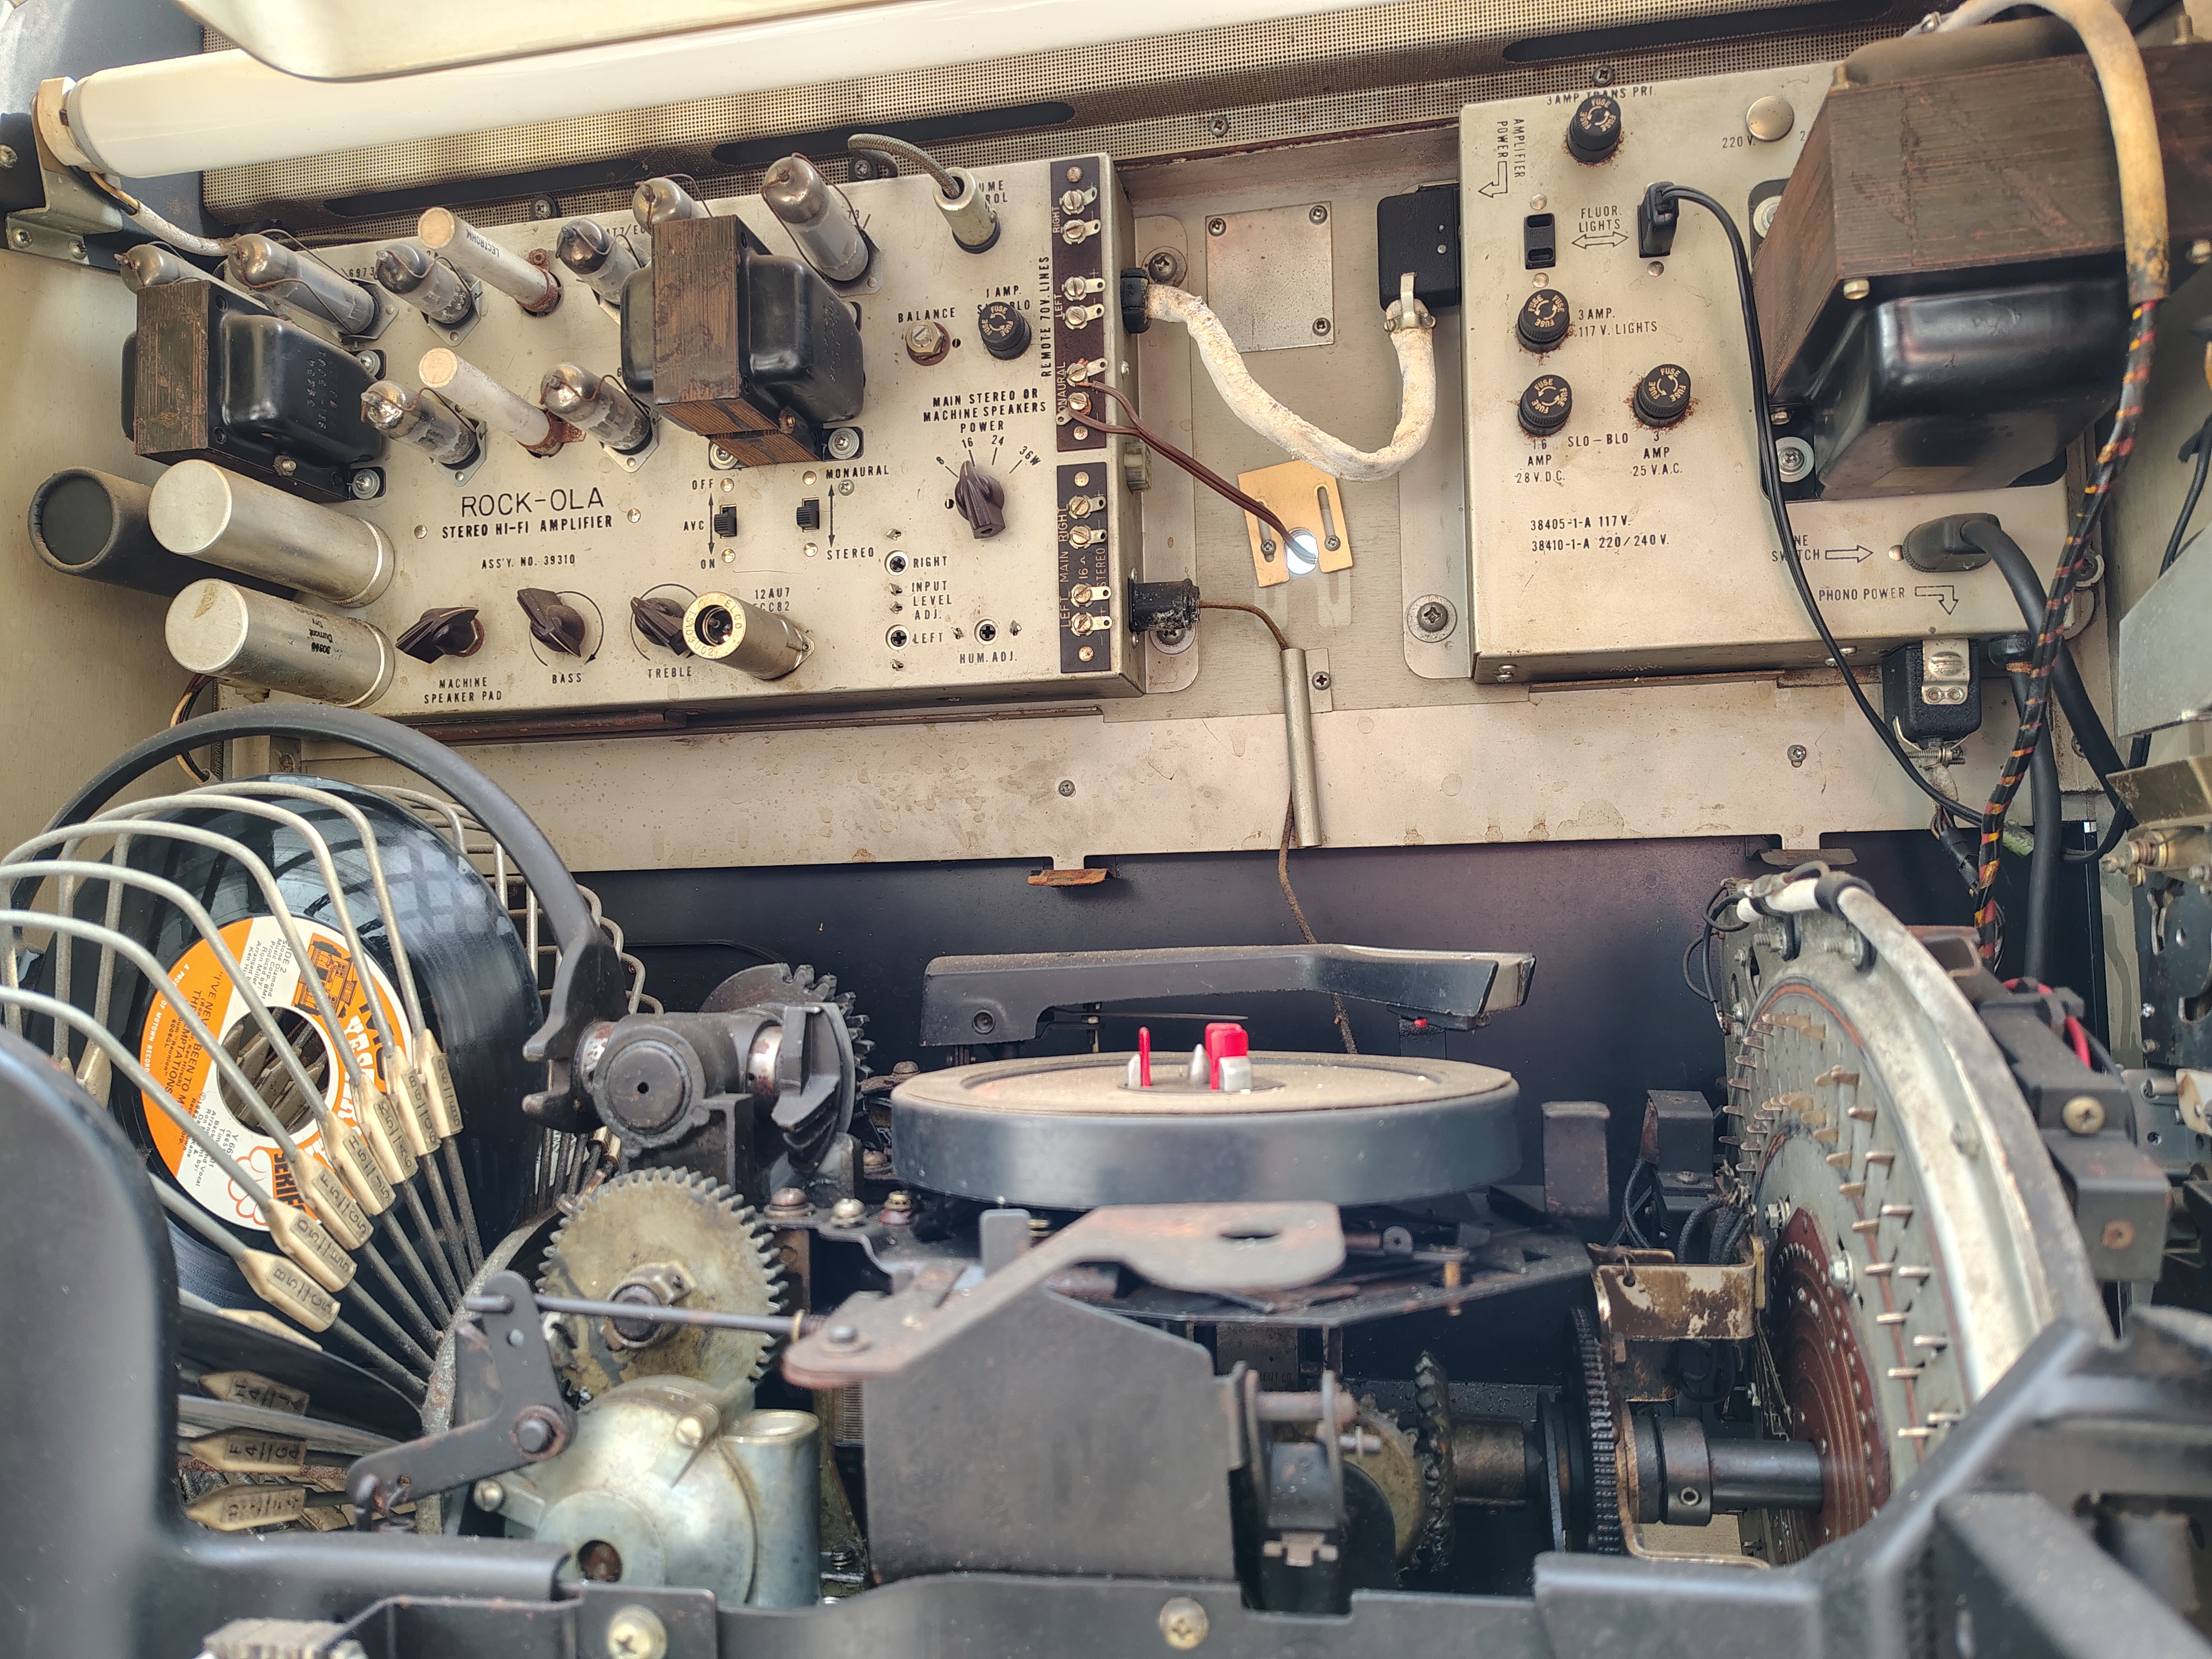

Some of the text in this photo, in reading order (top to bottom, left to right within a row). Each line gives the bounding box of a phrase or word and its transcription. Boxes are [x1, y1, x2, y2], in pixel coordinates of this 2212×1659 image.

[1555, 93, 1580, 104] AMP
[1591, 98, 1611, 108] FUSE
[1580, 111, 1592, 130] FUSE
[1600, 114, 1616, 132] FUSE
[1496, 120, 1508, 158] POWER
[1722, 137, 1743, 149] 220
[1514, 118, 1526, 178] AMPLIFIER
[1581, 205, 1622, 218] FLUOR.
[1052, 206, 1061, 233] RIGHT
[1579, 219, 1620, 233] LIGHTS
[466, 231, 500, 258] LECTROHM
[995, 285, 1022, 297] AMP.
[990, 306, 1008, 314] FUSE
[1054, 294, 1063, 318] LEFT
[1528, 294, 1544, 312] FUSE
[1552, 294, 1565, 313] FUSE
[898, 307, 956, 323] BALANCE
[1578, 308, 1615, 321] 3 AMP.
[982, 319, 993, 336] FUSE
[1000, 321, 1014, 336] FUSE
[1535, 318, 1554, 328] FUSE
[1579, 322, 1657, 338] 117 V. LIGHTS
[1040, 327, 1052, 377] REMOTE
[1660, 367, 1681, 377] FUSE
[1534, 378, 1554, 392] FUSE
[1648, 380, 1659, 400] FUSE
[933, 388, 1038, 407] MAIN STEREO OR
[1558, 387, 1567, 407] FUSE
[1669, 384, 1687, 402] FUSE
[923, 403, 1046, 422] MACHINE SPEAKERS
[1531, 399, 1549, 414] FUSE
[960, 420, 1004, 433] POWER
[961, 437, 973, 449] 16
[991, 434, 1004, 446] 24
[1653, 430, 1660, 442] 3
[936, 456, 945, 465] 8
[1019, 446, 1041, 466] 36W
[1527, 454, 1552, 466] AMP
[1643, 447, 1670, 459] AMP
[826, 466, 889, 480] MONAURAL
[1633, 464, 1647, 477] 25
[692, 478, 715, 491] OFF
[461, 487, 605, 517] ROCK-OLA
[442, 514, 613, 538] STEREO HI-FI AMPLIFIER
[683, 520, 705, 531] AVC
[1057, 507, 1068, 542] RIGHT
[1530, 514, 1631, 531] 38405-1-A 117 V.
[1532, 538, 1590, 552] 38410-1-A
[1661, 534, 1670, 545] V.
[520, 556, 539, 568] NO.
[543, 554, 576, 566] 39310
[826, 547, 874, 560] STEREO
[700, 558, 715, 569] ON
[913, 556, 948, 569] RIGHT
[1060, 551, 1069, 582] MAIN
[1096, 547, 1107, 587] STEREO
[754, 588, 790, 599] 12AU7
[911, 581, 948, 592] INPUT
[913, 594, 953, 606] LEVEL
[1819, 587, 1905, 602] PHONO POWER
[724, 599, 743, 629] ELCO
[915, 608, 942, 621] ADJ.
[1060, 596, 1071, 627] LEFT
[913, 632, 944, 644] LEFT
[960, 651, 1018, 664] HUM. ADJ.
[552, 672, 583, 685] BASS
[648, 666, 693, 680] TREBLE
[439, 676, 489, 689] MACHINE
[424, 689, 503, 704] SPEAKER PAD
[246, 946, 254, 961] Ken
[272, 938, 282, 960] Music
[248, 940, 261, 974] Arranged
[262, 940, 275, 975] Produced
[253, 946, 268, 986] Ron Miller
[265, 961, 275, 981] Corp.
[268, 963, 281, 997] Diamond
[149, 1011, 162, 1042] MOTOWN
[186, 1043, 202, 1074] BEEN
[181, 1076, 192, 1092] TO
[195, 1165, 206, 1187] Vocal
